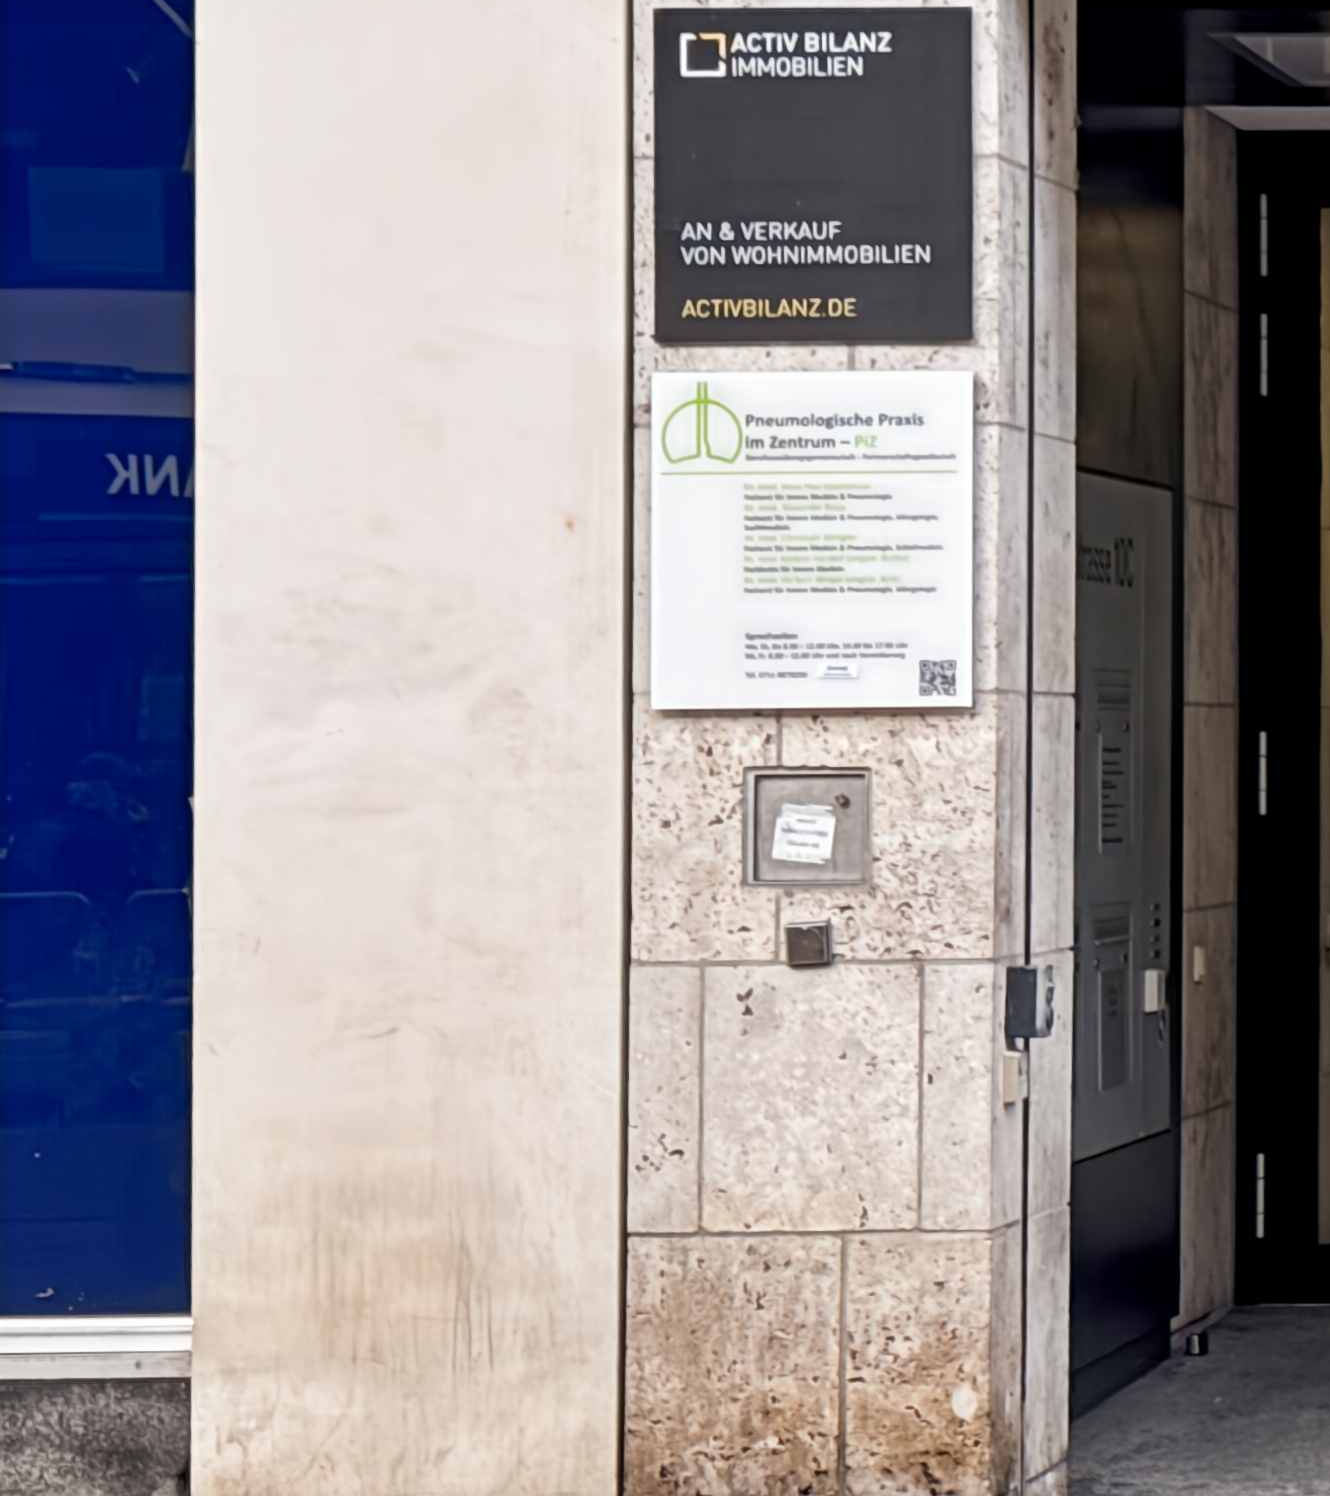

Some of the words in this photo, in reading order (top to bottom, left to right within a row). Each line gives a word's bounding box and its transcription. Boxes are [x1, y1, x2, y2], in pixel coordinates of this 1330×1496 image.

[730, 32, 798, 53] ACTIV
[804, 32, 892, 53] BILANZ
[731, 56, 864, 77] IMMOBILIEN
[681, 222, 712, 241] AN
[719, 222, 735, 241] &
[741, 221, 842, 241] VERKAUF
[681, 246, 726, 265] VON
[731, 244, 931, 265] WOHNIMMOBILIEN
[681, 298, 857, 318] ACTIVBILANZ.DE
[745, 413, 874, 430] Pneumologische
[878, 413, 925, 427] Praxis
[769, 435, 836, 449] Zentrum
[855, 435, 878, 448] PiZ
